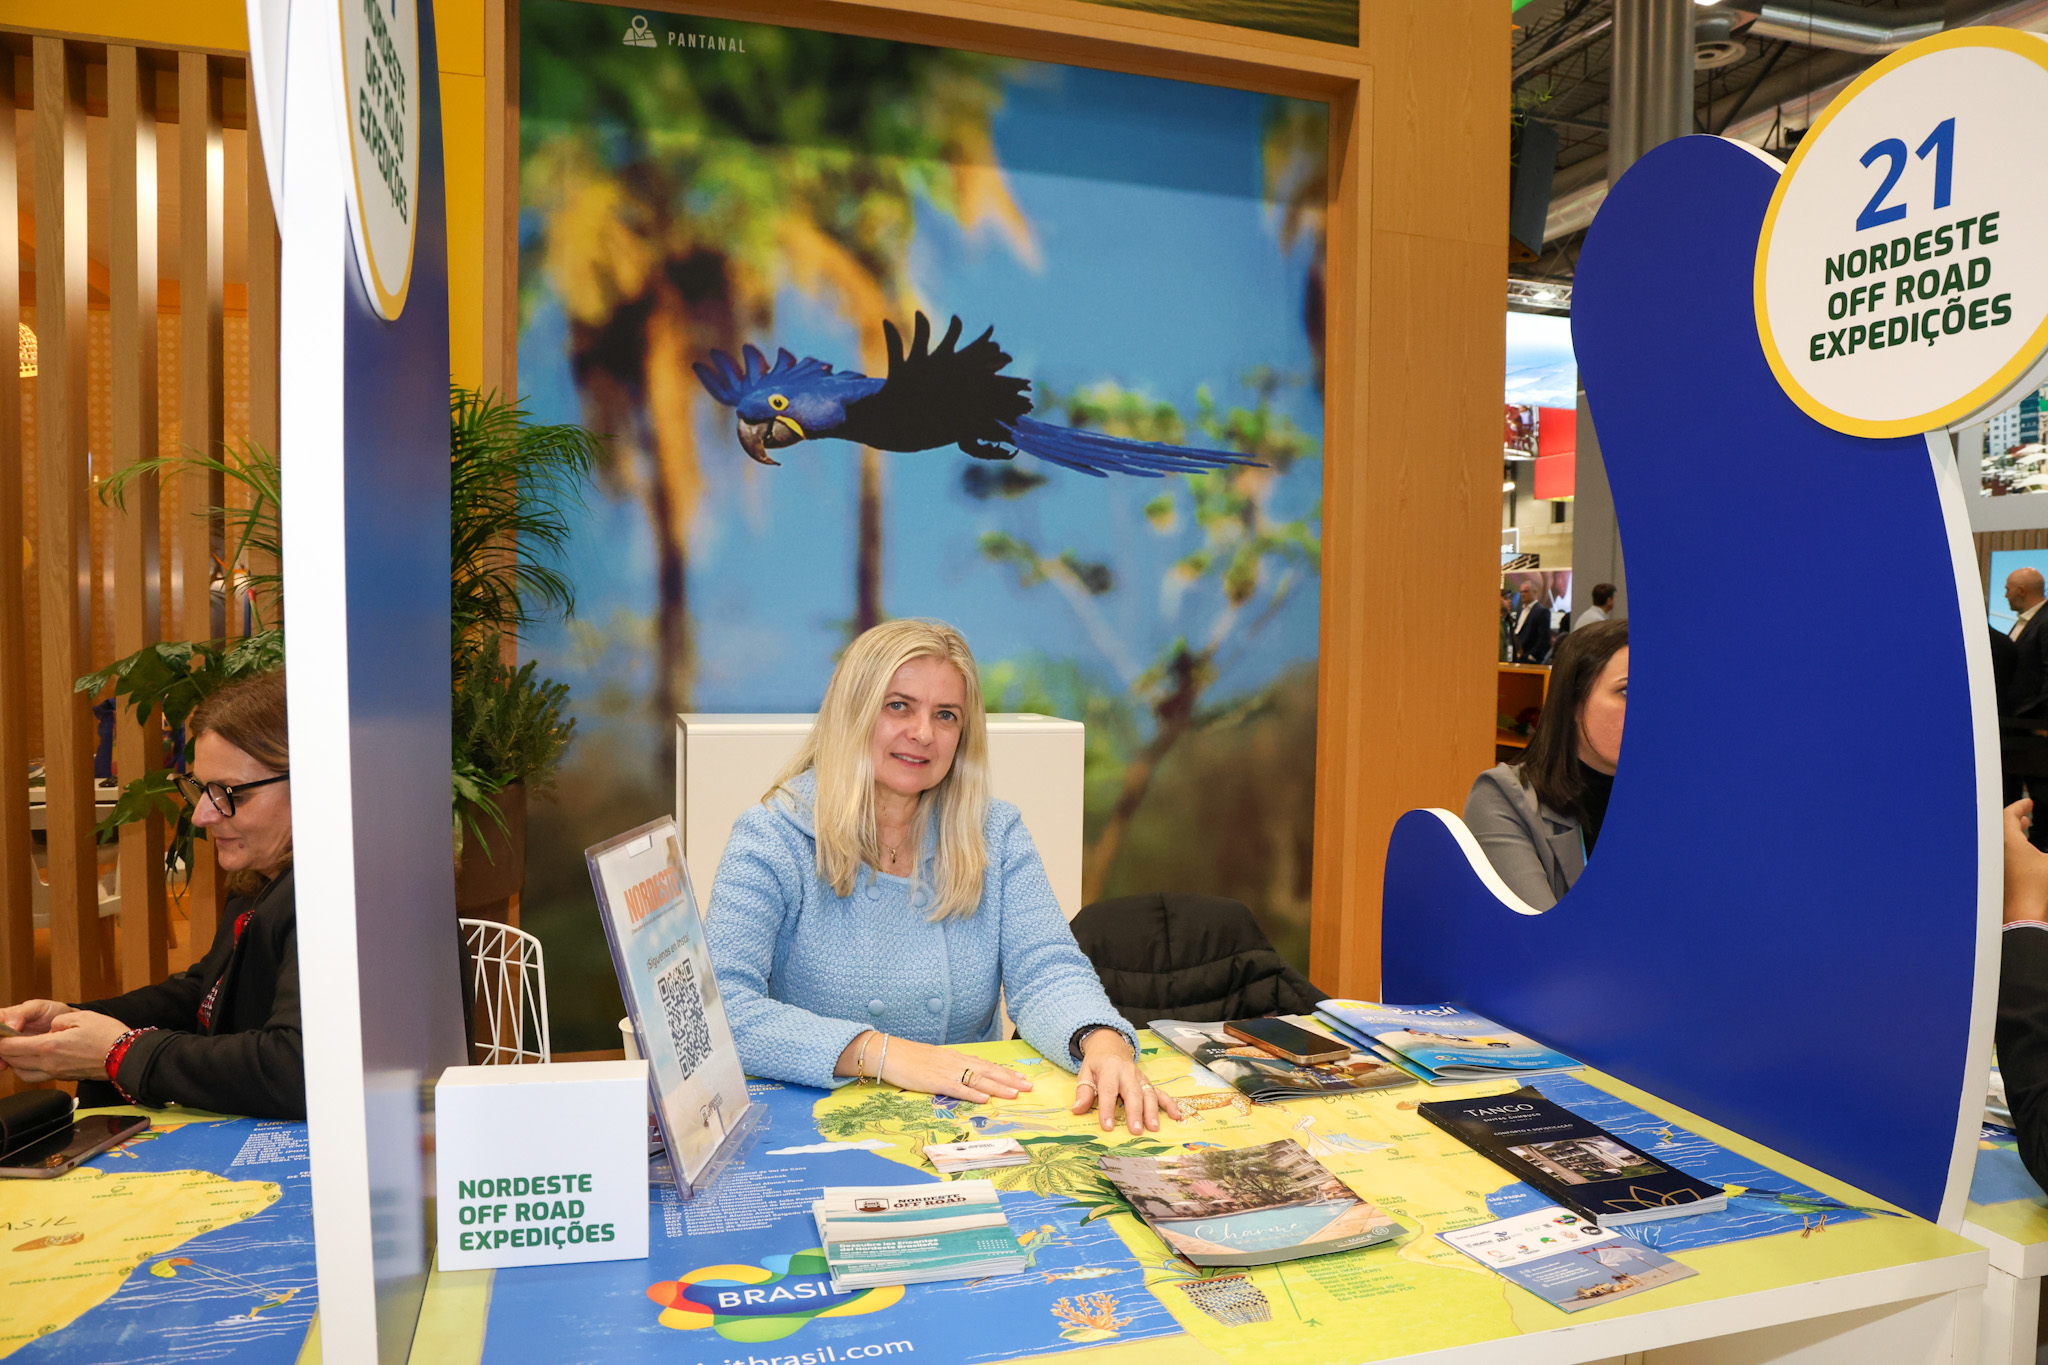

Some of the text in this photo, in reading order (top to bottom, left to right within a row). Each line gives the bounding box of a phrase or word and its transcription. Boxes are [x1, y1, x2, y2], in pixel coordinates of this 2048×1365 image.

[668, 31, 746, 53] PANTANAL
[365, 37, 404, 163] OFF ROAD
[359, 86, 407, 224] EXPEDIÇÕES
[1856, 117, 1955, 232] 21
[1825, 211, 2000, 285] NORDESTE
[1828, 256, 1991, 320] OFF ROAD
[1809, 293, 2012, 362] EXPEDIÇÕES
[624, 866, 681, 924] NORDESTE
[1391, 1005, 1460, 1018] Brasil
[1463, 1104, 1534, 1117] TANGO
[459, 1174, 592, 1199] NORDESTE
[898, 1193, 961, 1203] NORDESTE
[459, 1200, 585, 1225] OFF ROAD
[925, 1197, 967, 1206] ROAD
[0, 1216, 77, 1230] ASIL
[1416, 1210, 1449, 1219] CURITIBA
[460, 1221, 615, 1251] EXPEDIÇÕES
[726, 1224, 773, 1232] International
[1194, 1222, 1303, 1243] Charme
[718, 1281, 852, 1308] BRASIL
